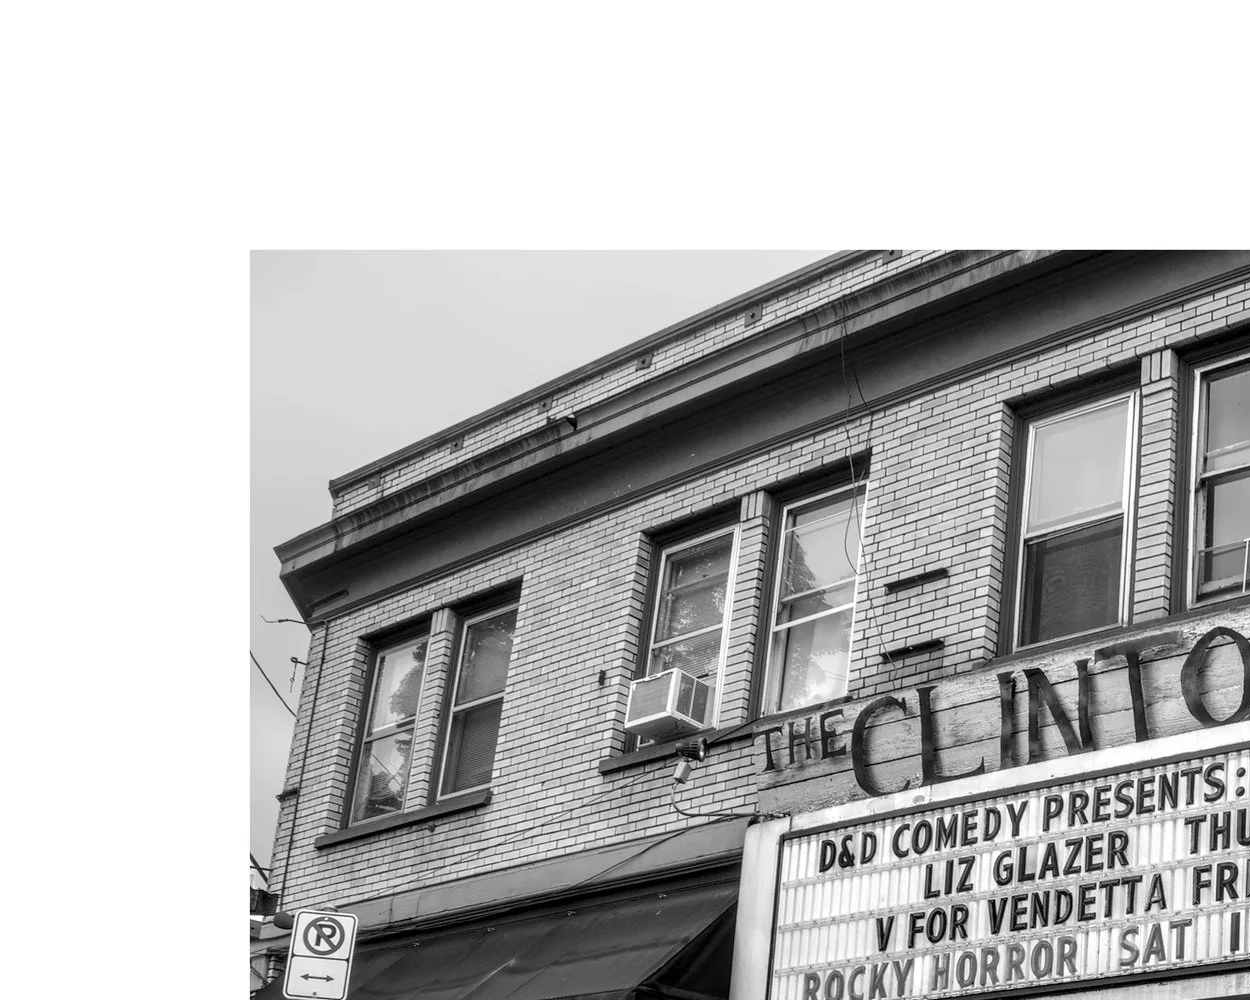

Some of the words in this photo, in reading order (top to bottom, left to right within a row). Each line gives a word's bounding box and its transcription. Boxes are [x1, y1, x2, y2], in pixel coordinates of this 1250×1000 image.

[753, 708, 847, 772] THE
[819, 831, 877, 873] D&D
[893, 800, 1028, 858] COMEDY
[924, 855, 976, 899] LIZ
[993, 830, 1129, 886] GLAZER
[876, 916, 895, 951] V
[908, 903, 969, 948] FOR
[988, 873, 1167, 935] VENDETTA
[932, 936, 1078, 991] HORROR
[1119, 918, 1192, 967] SAT
